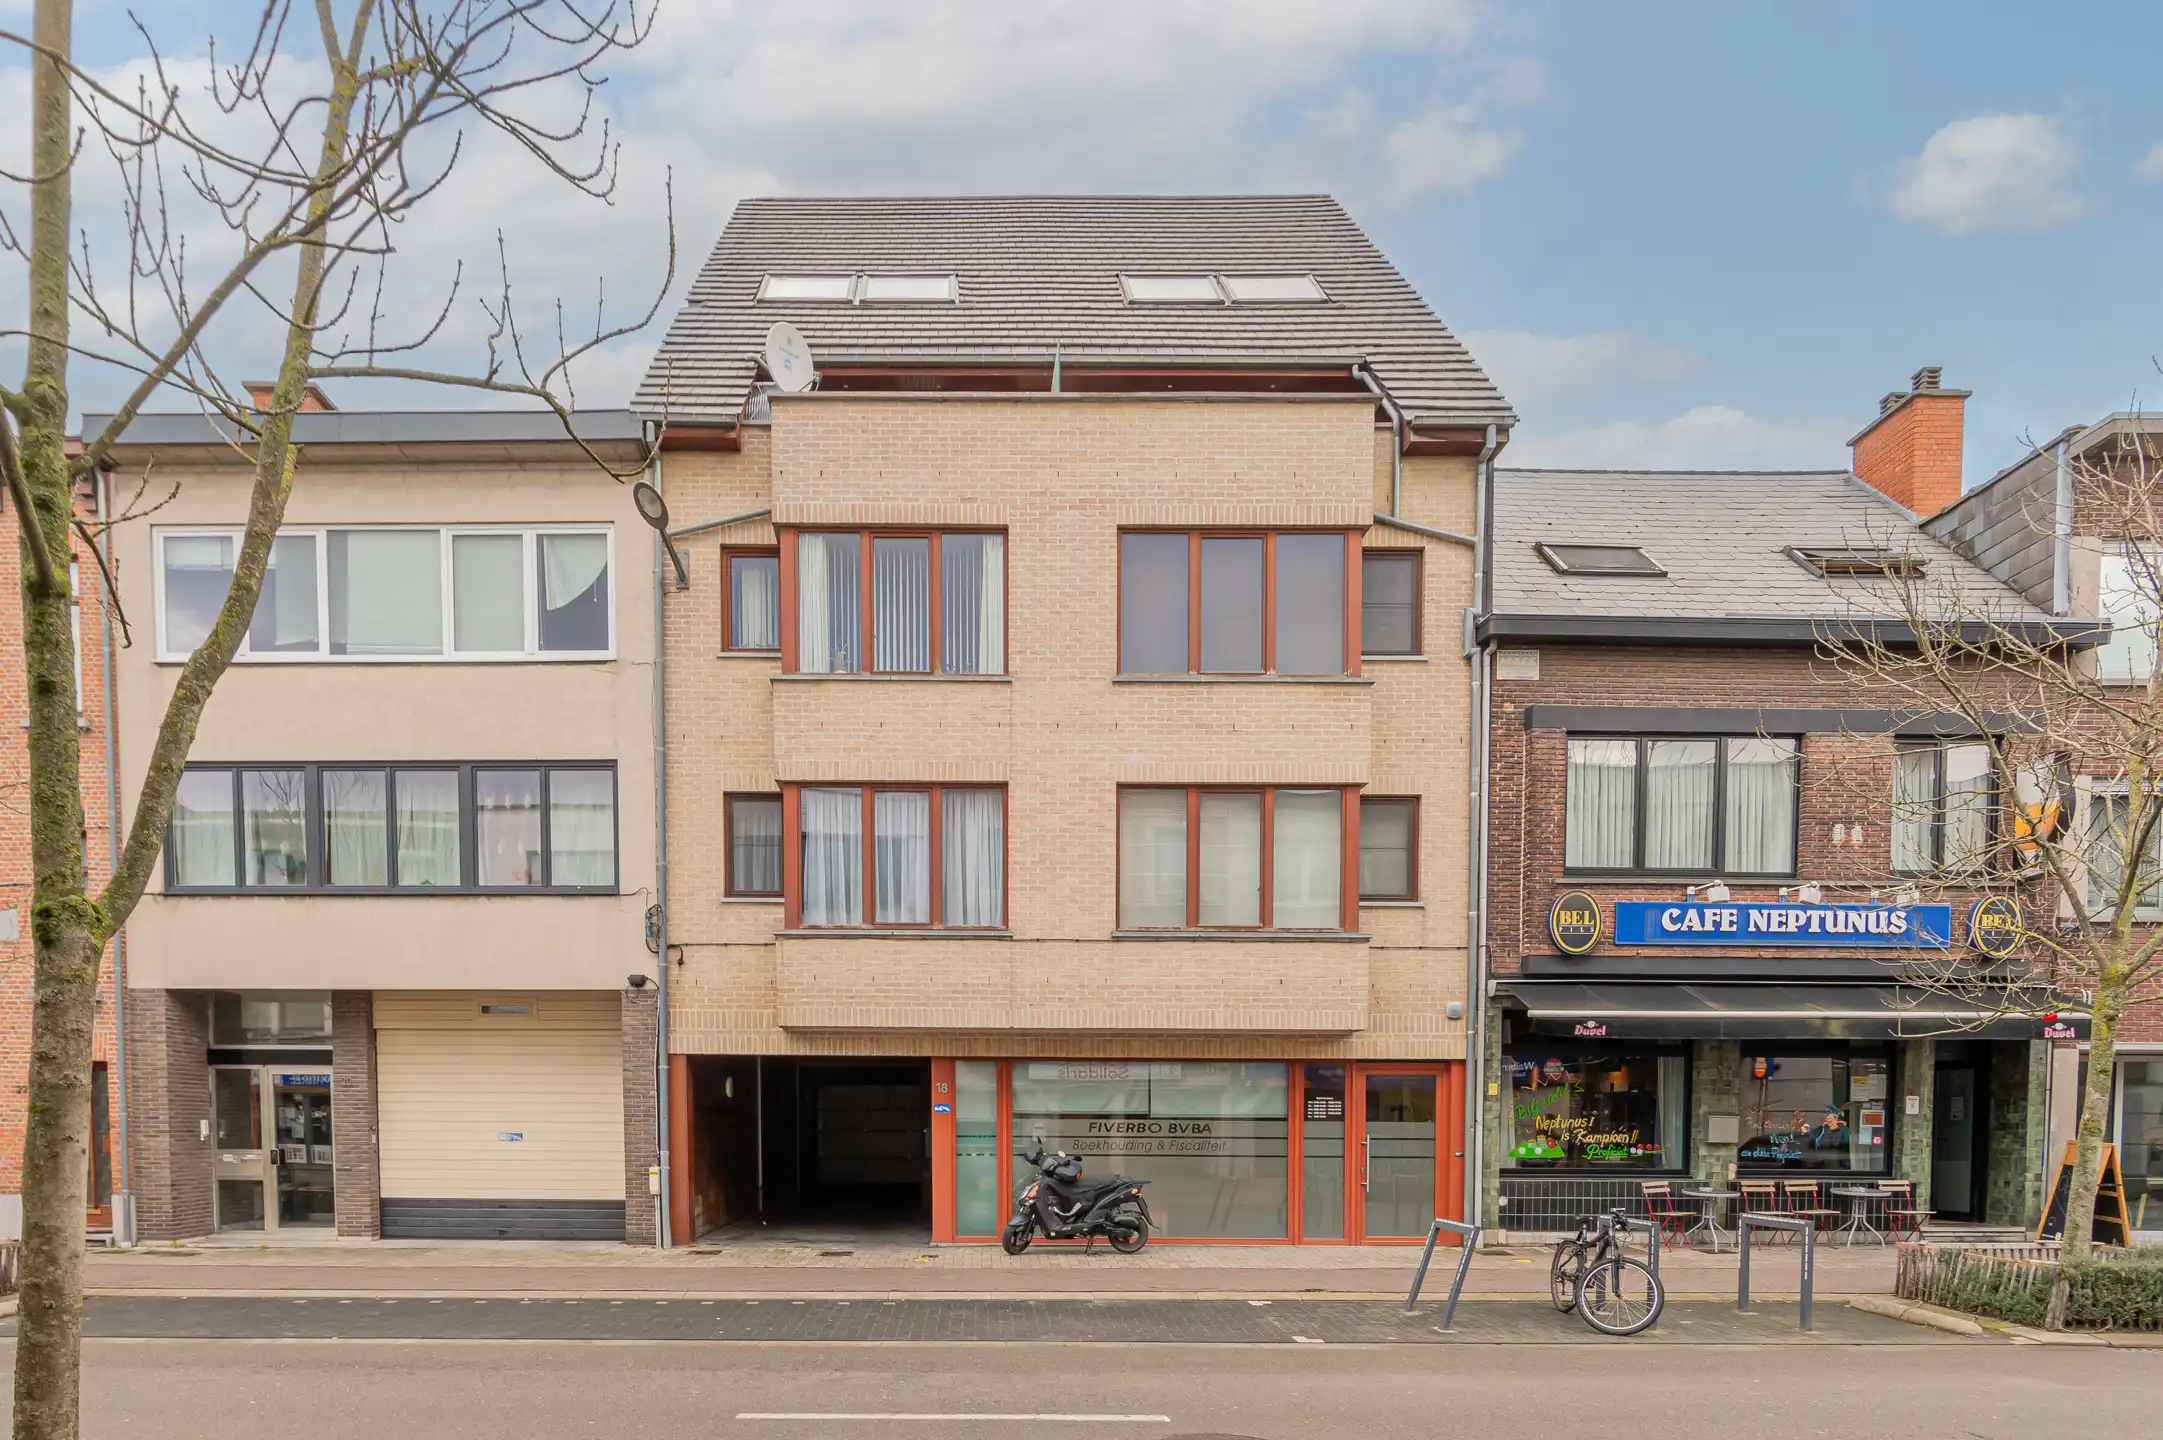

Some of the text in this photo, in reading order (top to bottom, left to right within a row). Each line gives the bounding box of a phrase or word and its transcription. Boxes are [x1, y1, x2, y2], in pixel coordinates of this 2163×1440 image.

[1559, 910, 1594, 925] BEL
[1661, 908, 1907, 934] CAFE NEPTUNUS
[1575, 1024, 1606, 1036] Duvel
[2044, 1026, 2075, 1038] Duvel
[936, 1082, 948, 1094] 18
[1088, 1122, 1212, 1134] FIVERBO BVBA
[1072, 1139, 1227, 1153] Boekhouding & Fiscaliteit
